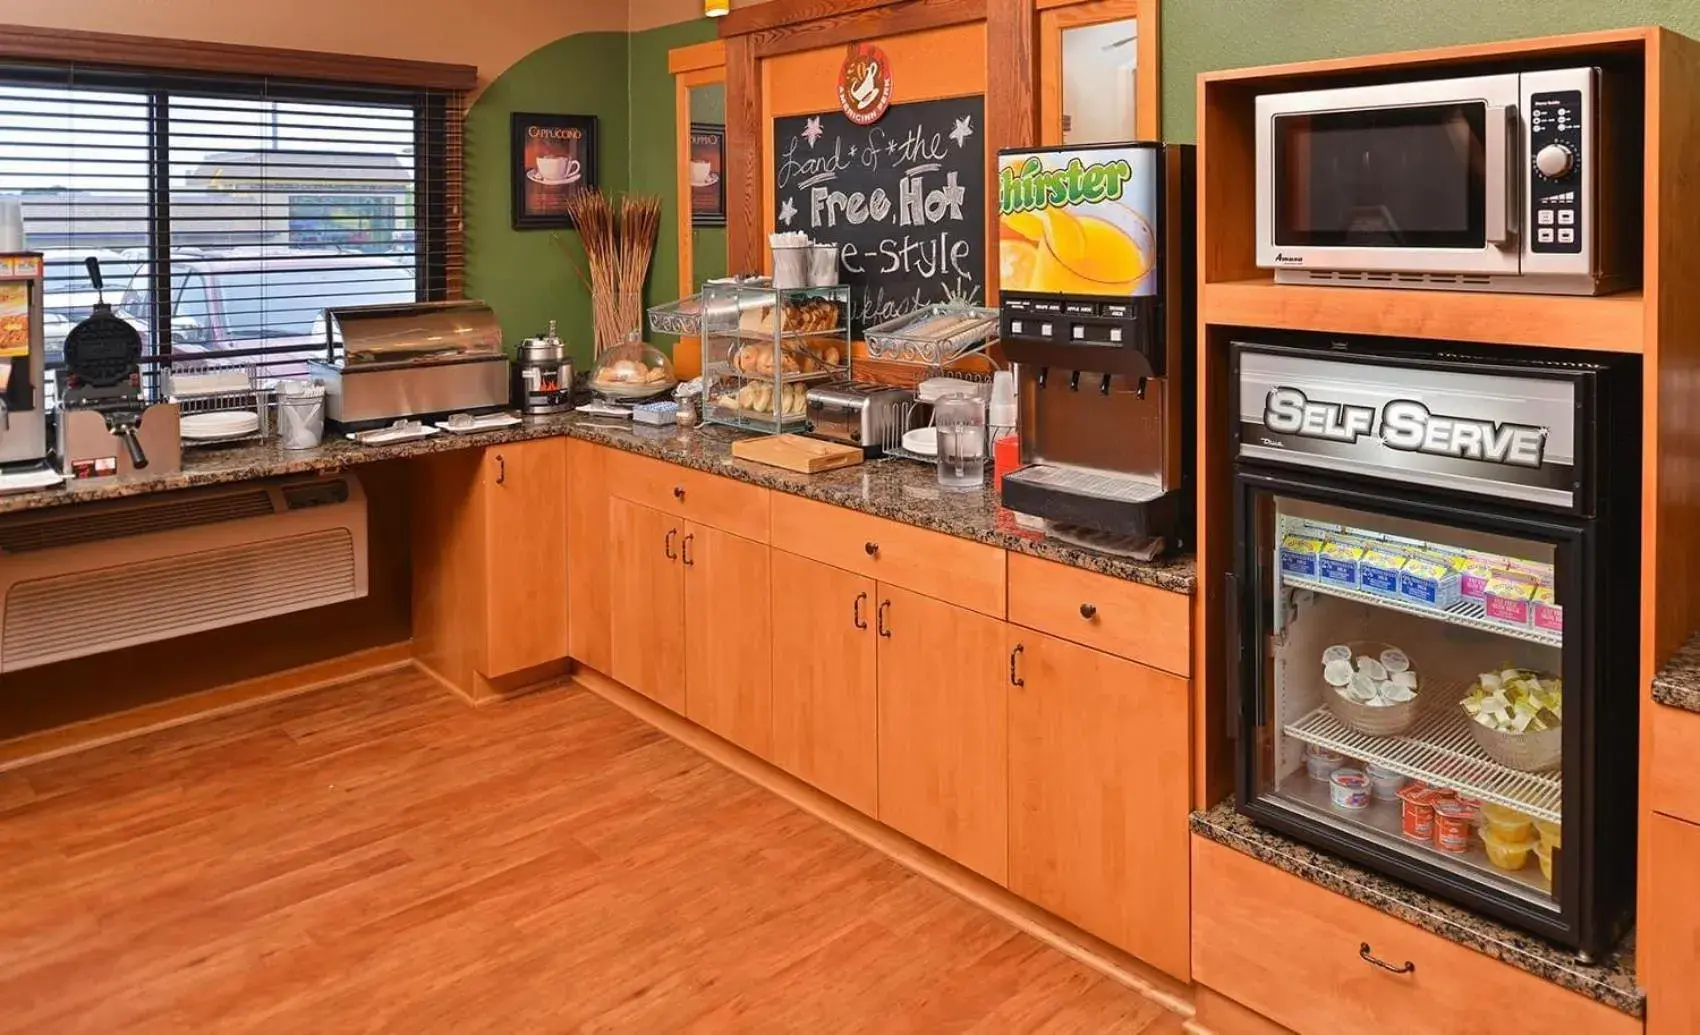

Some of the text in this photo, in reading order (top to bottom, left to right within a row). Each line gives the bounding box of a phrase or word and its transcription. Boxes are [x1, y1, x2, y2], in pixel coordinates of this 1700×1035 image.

[839, 86, 877, 120] AMERICINN
[528, 126, 582, 140] CAPPUCCINO
[778, 125, 948, 188] Land of the
[899, 171, 965, 226] Hot
[1000, 157, 1131, 215] hirster
[841, 232, 972, 280] e-style
[1265, 387, 1546, 468] SELF SERVE
